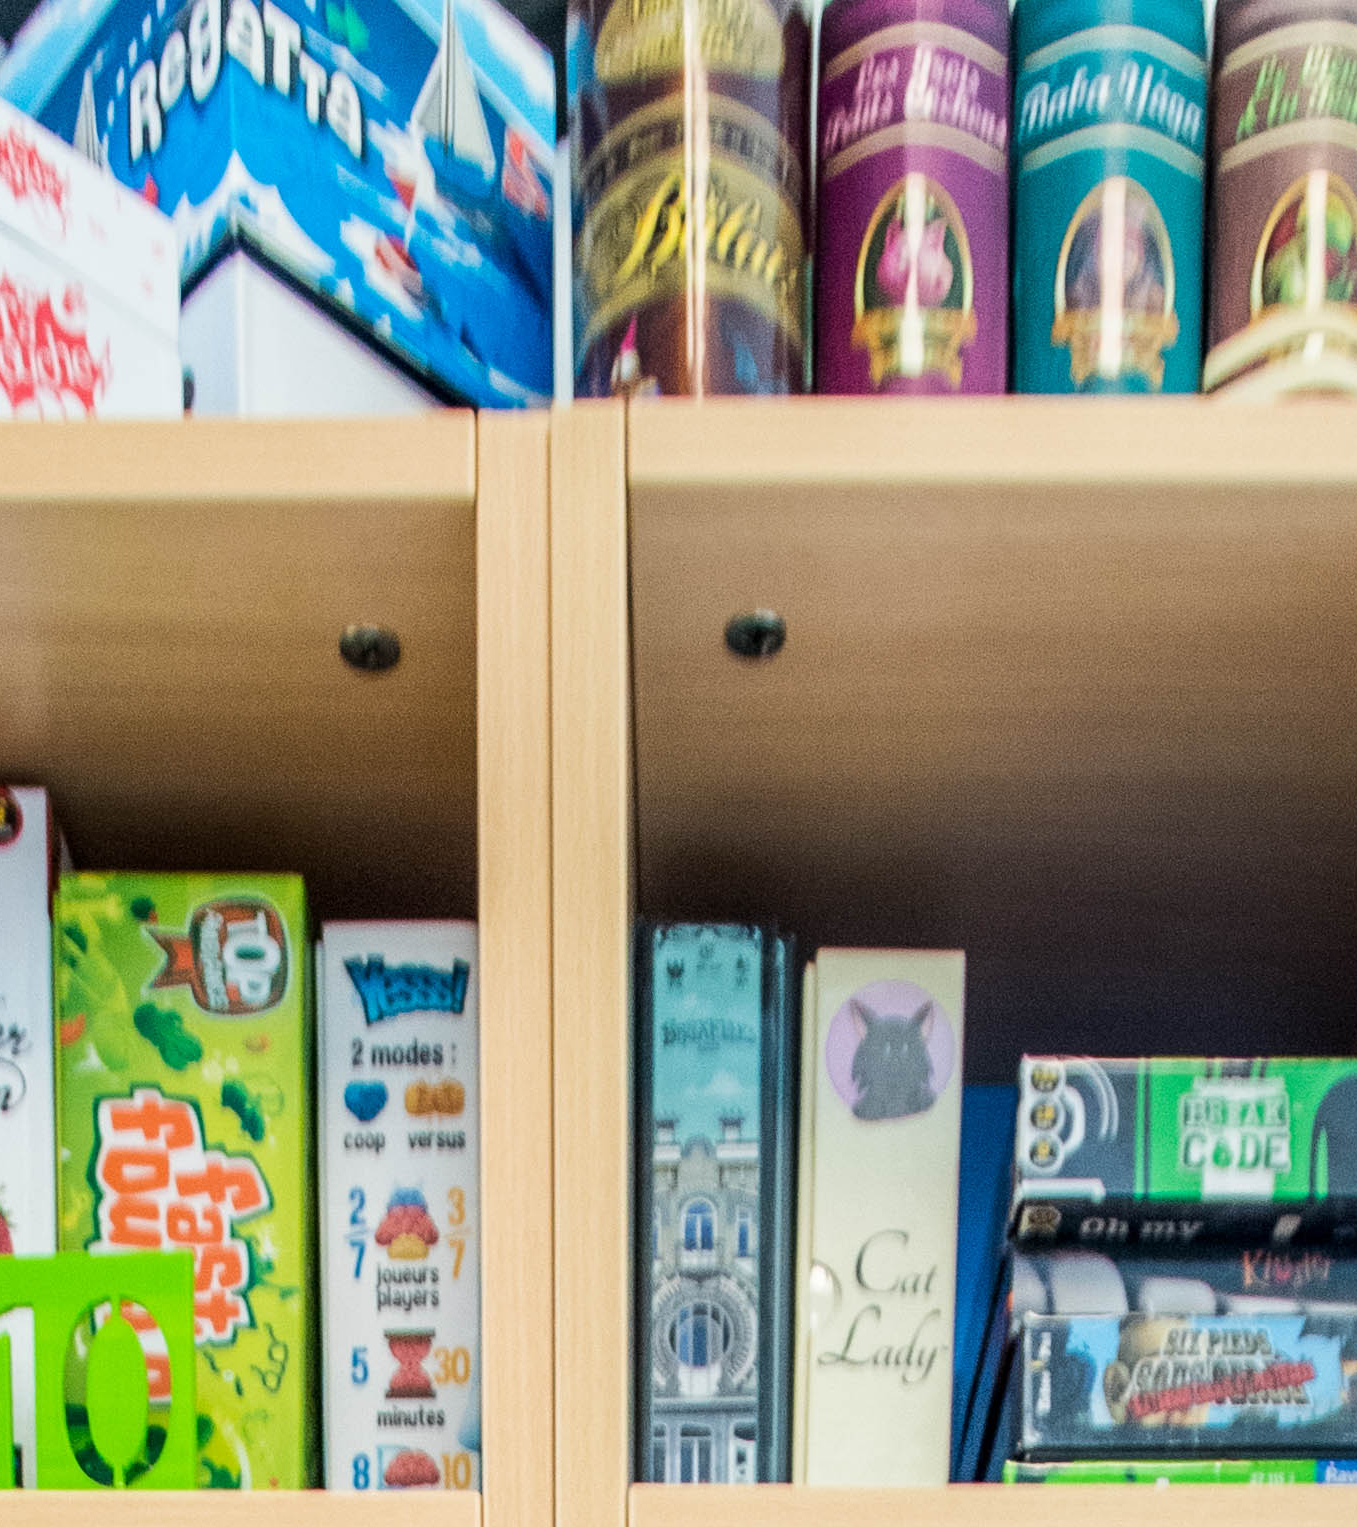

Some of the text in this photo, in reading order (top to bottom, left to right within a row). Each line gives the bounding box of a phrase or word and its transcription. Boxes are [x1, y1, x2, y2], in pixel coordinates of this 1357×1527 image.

[350, 1038, 444, 1066] 2 modes
[343, 1131, 386, 1156] coop
[407, 1129, 467, 1151] versus
[375, 1260, 440, 1288] joueurs
[855, 1229, 939, 1297] Cat
[375, 1283, 440, 1314] players
[816, 1305, 947, 1383] Lady
[350, 1347, 369, 1385] 5
[433, 1346, 473, 1385] 30
[376, 1405, 446, 1429] minutes
